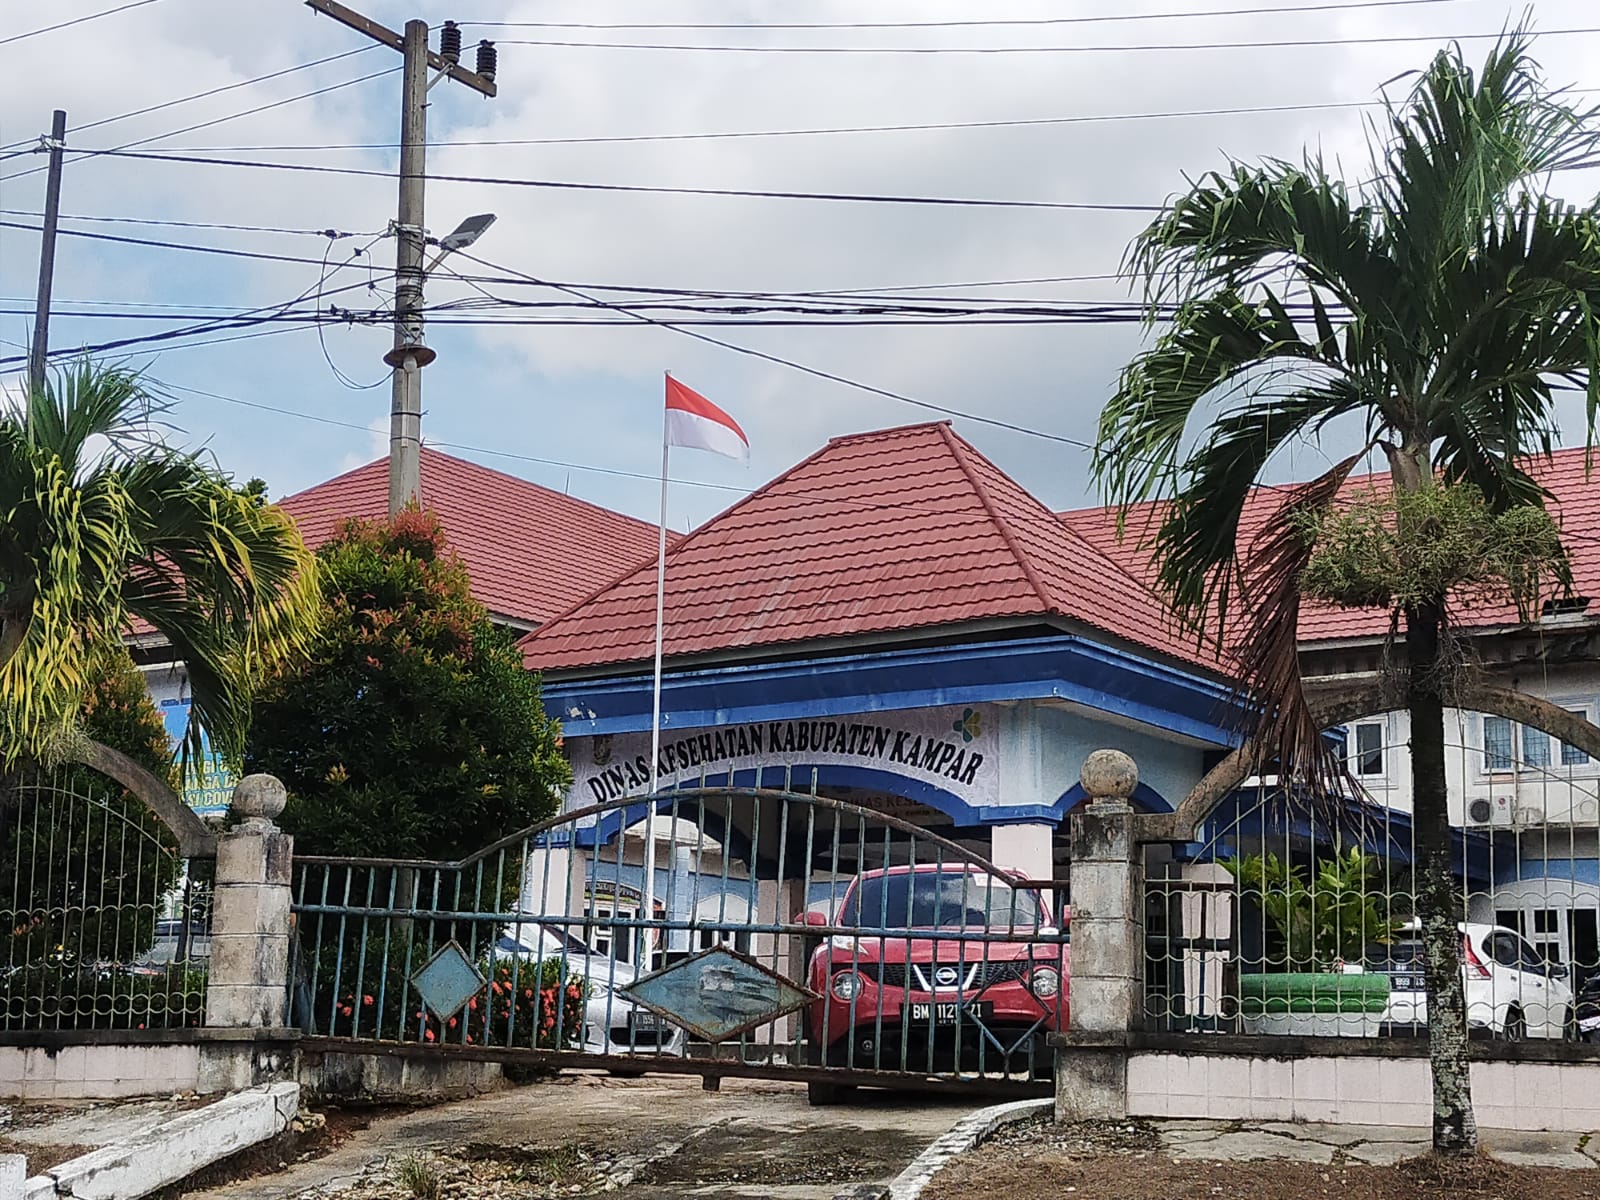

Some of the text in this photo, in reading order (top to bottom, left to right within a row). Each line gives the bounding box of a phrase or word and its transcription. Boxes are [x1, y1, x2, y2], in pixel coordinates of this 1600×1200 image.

[587, 755, 650, 803] DINAS
[769, 721, 891, 759] KABUPATEN
[889, 731, 984, 785] KAMPAR
[913, 1004, 930, 1019] BM
